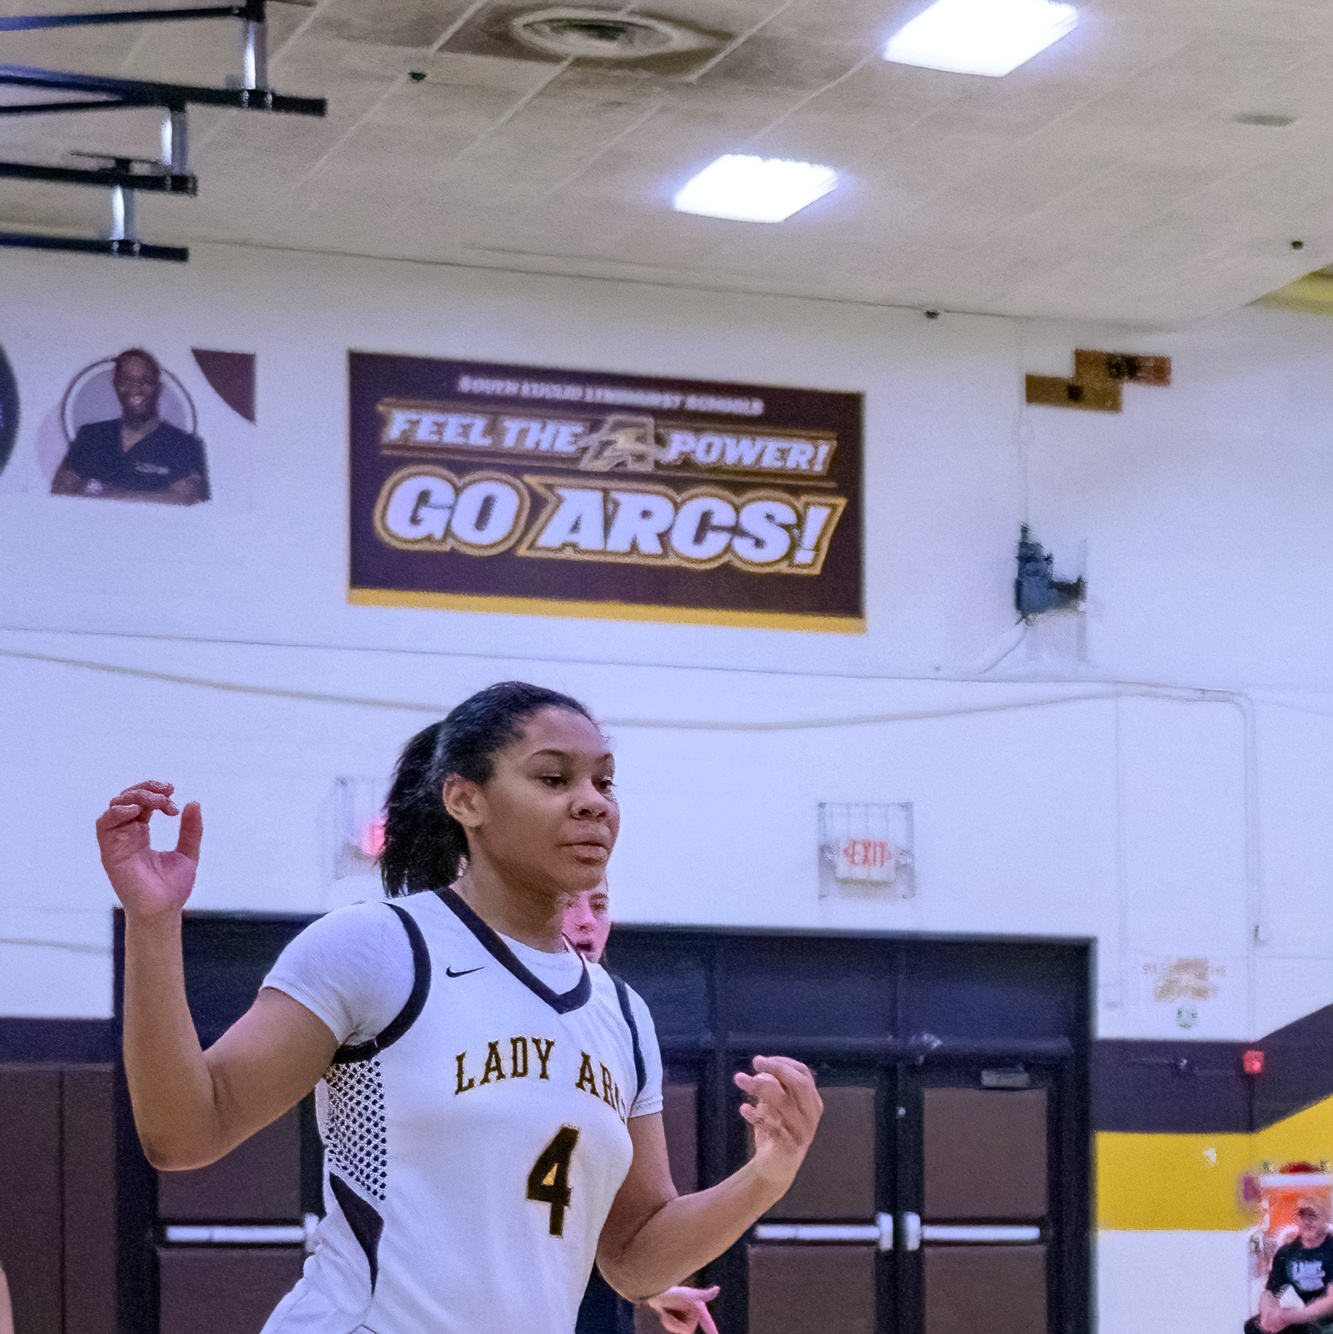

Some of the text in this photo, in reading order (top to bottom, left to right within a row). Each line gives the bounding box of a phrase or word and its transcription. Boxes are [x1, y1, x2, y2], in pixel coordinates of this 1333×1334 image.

[388, 409, 493, 447] FEEL
[501, 419, 585, 453] THE
[661, 429, 832, 472] POWER!
[385, 475, 833, 565] GO ARCS!
[454, 1036, 556, 1096] LADY
[526, 1123, 581, 1239] 4
